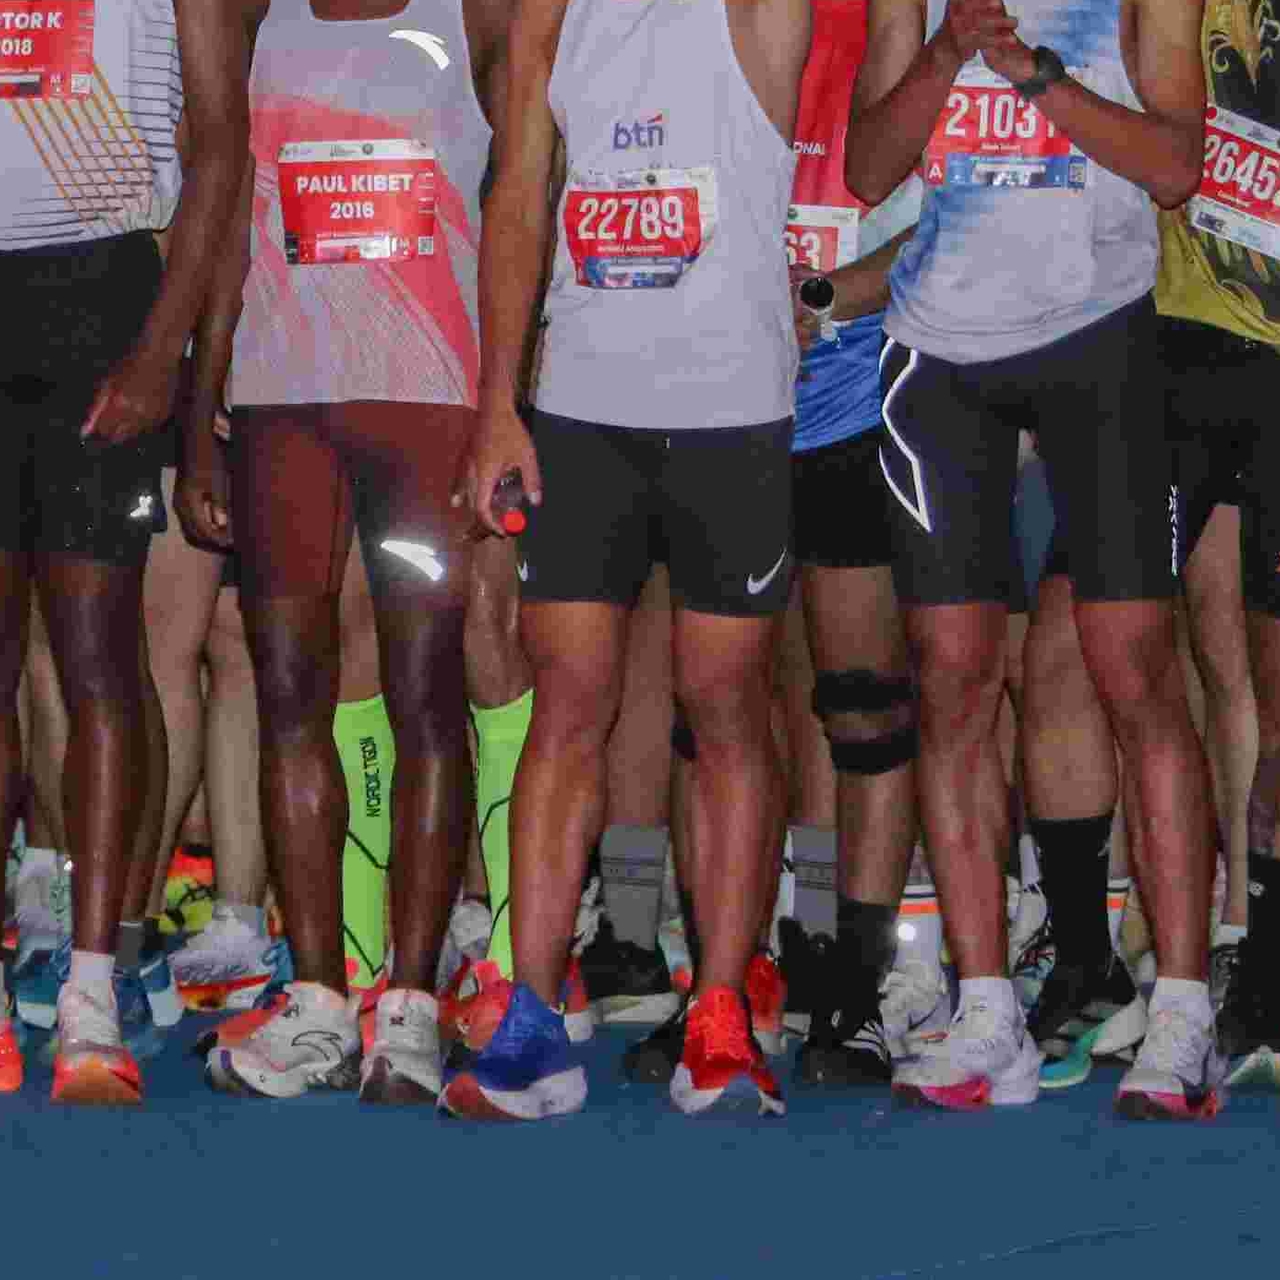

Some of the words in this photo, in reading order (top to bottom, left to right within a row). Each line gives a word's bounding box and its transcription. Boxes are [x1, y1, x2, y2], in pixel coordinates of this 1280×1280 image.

[46, 11, 64, 29] K
[296, 174, 348, 194] PAUL
[351, 173, 414, 193] KIBET
[577, 195, 685, 241] 22789
